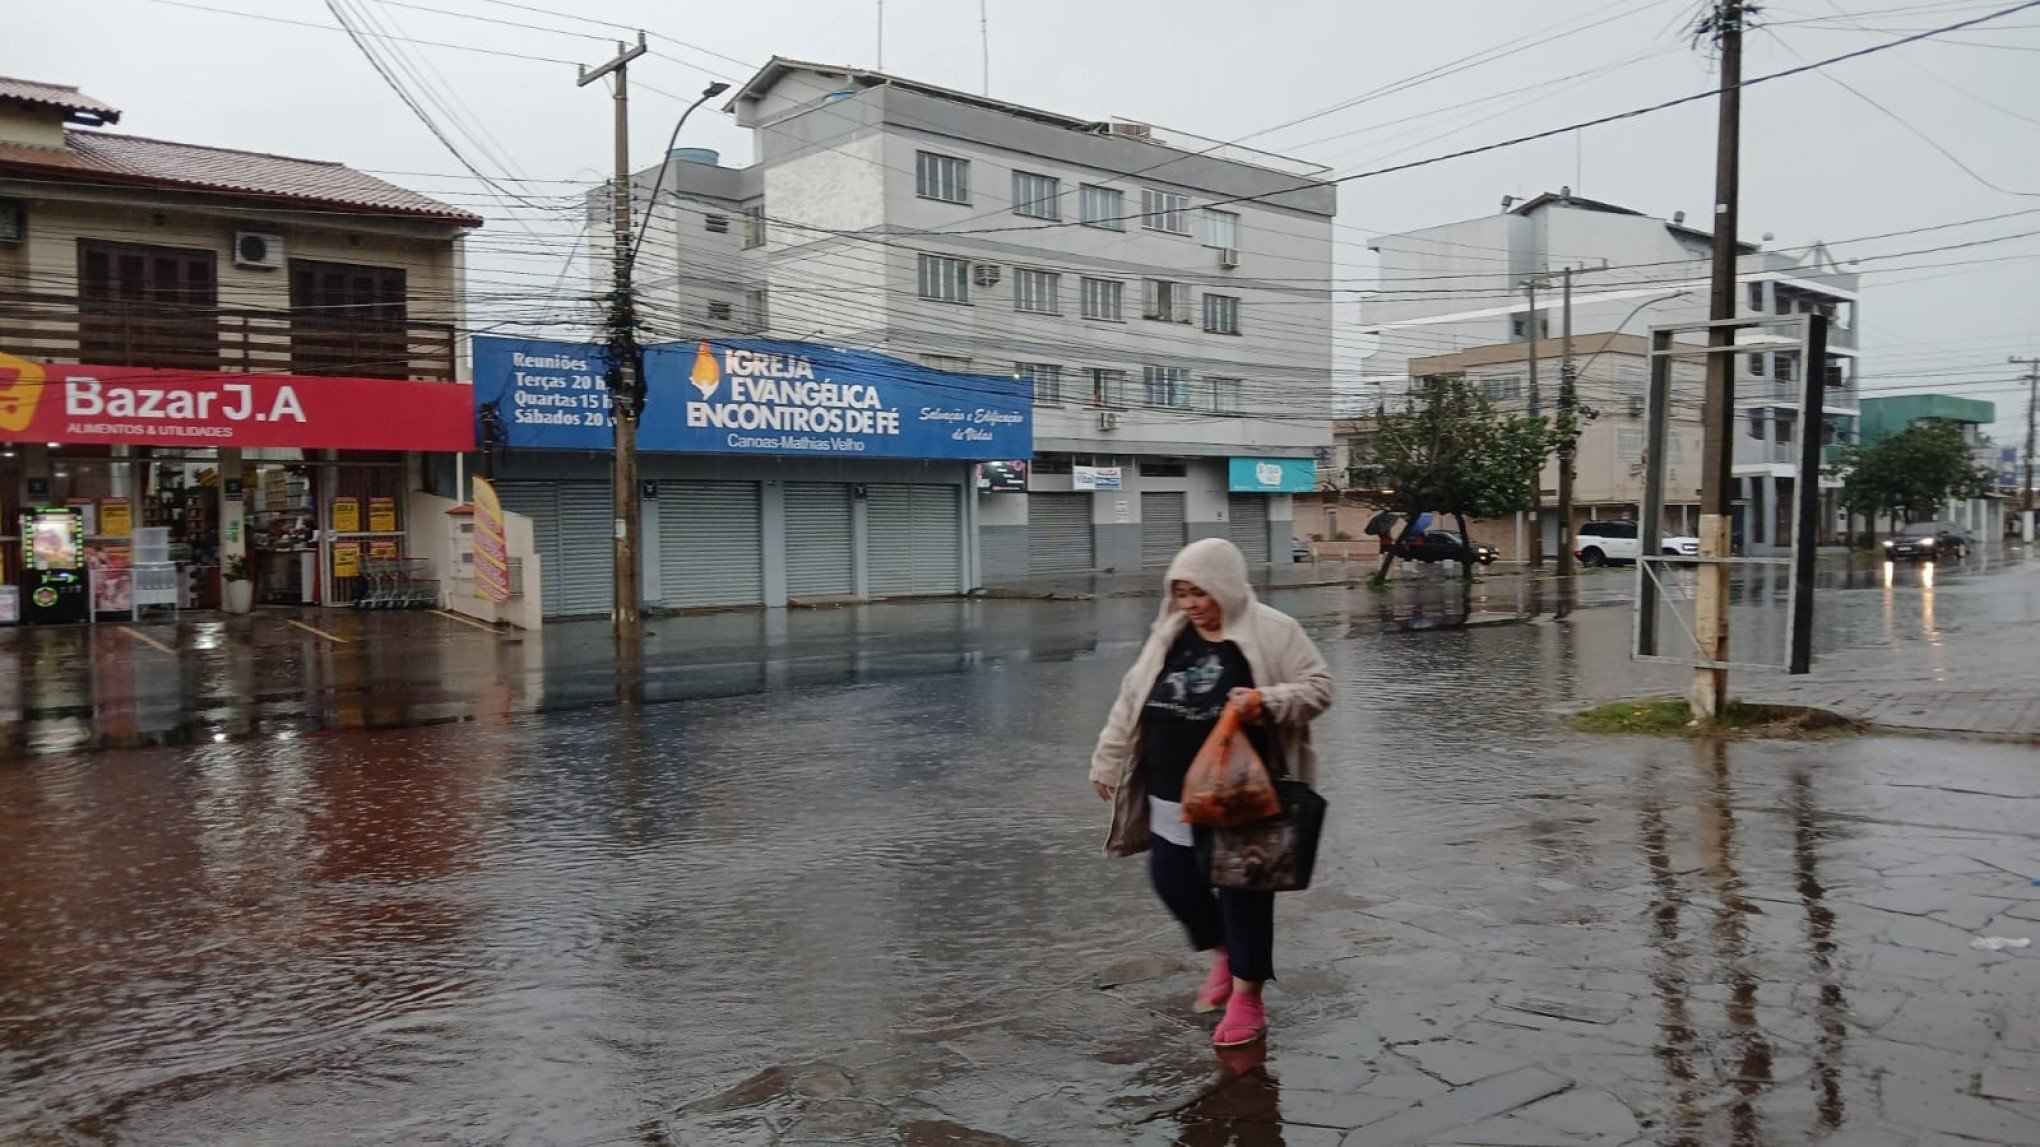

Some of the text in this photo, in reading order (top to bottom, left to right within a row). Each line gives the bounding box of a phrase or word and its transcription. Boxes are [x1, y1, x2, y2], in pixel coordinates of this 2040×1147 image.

[513, 353, 588, 371] Reuniões
[725, 349, 815, 380] IGREJA
[515, 372, 567, 390] Terças
[571, 375, 592, 390] 20
[65, 376, 307, 423] Bazar J.A
[514, 390, 578, 407] Quartas
[580, 394, 599, 409] 15
[731, 377, 882, 409] EVANGÉLICA
[514, 408, 581, 425] Sábados
[583, 412, 604, 427] 20
[686, 402, 900, 435] ENCONTROS DE FÉ
[66, 423, 233, 437] ALIMENTOS & UTILIDADES
[830, 437, 865, 450] Velho
